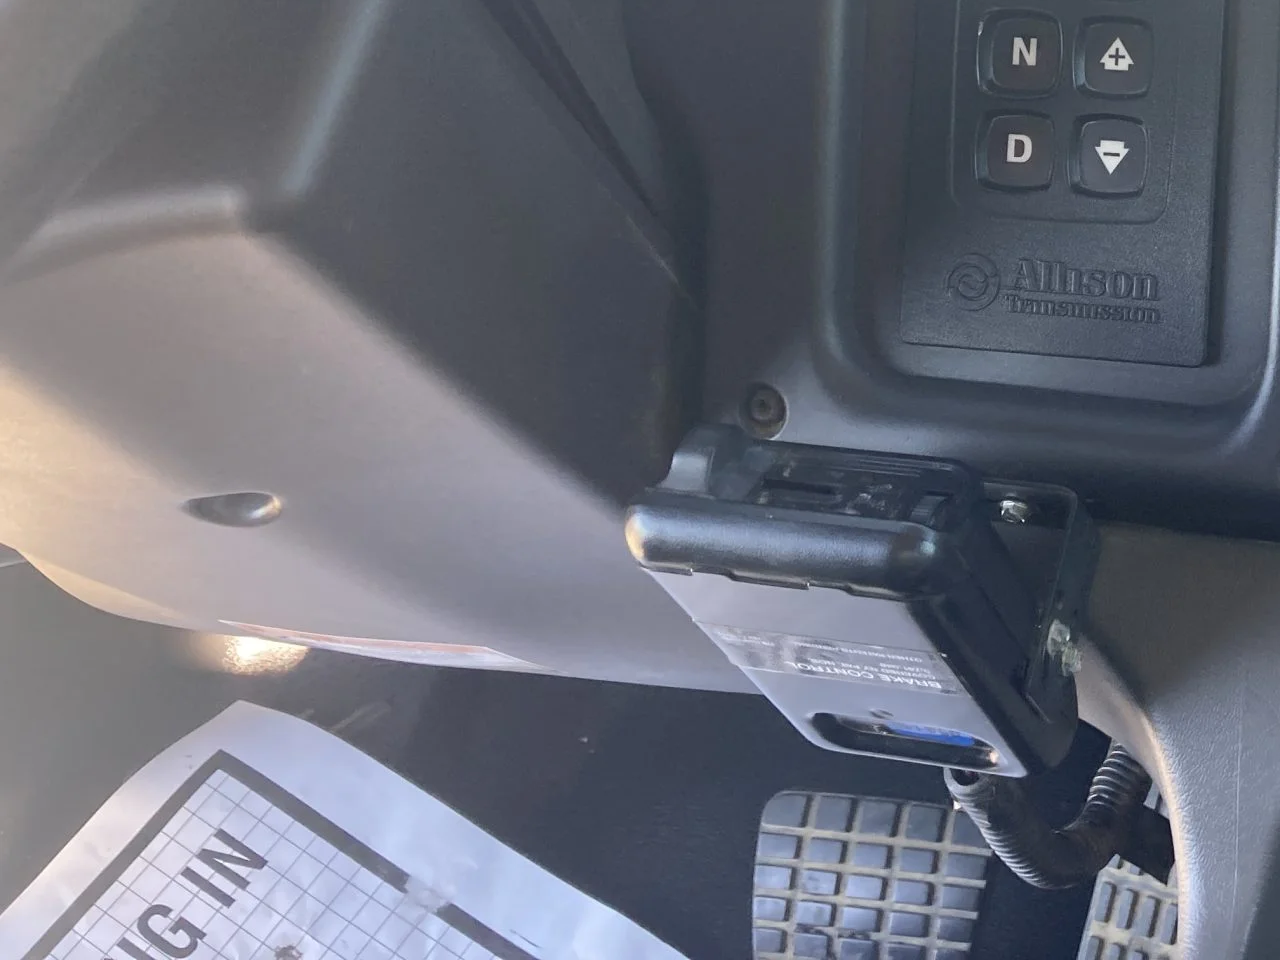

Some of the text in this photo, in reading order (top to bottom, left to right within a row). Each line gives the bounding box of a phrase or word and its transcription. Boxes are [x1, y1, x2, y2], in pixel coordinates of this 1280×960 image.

[1011, 37, 1038, 67] N
[1006, 133, 1034, 164] D
[1015, 257, 1160, 301] Allison
[783, 660, 875, 680] CONTROL
[877, 673, 942, 689] BRAKE
[181, 828, 269, 909] IN
